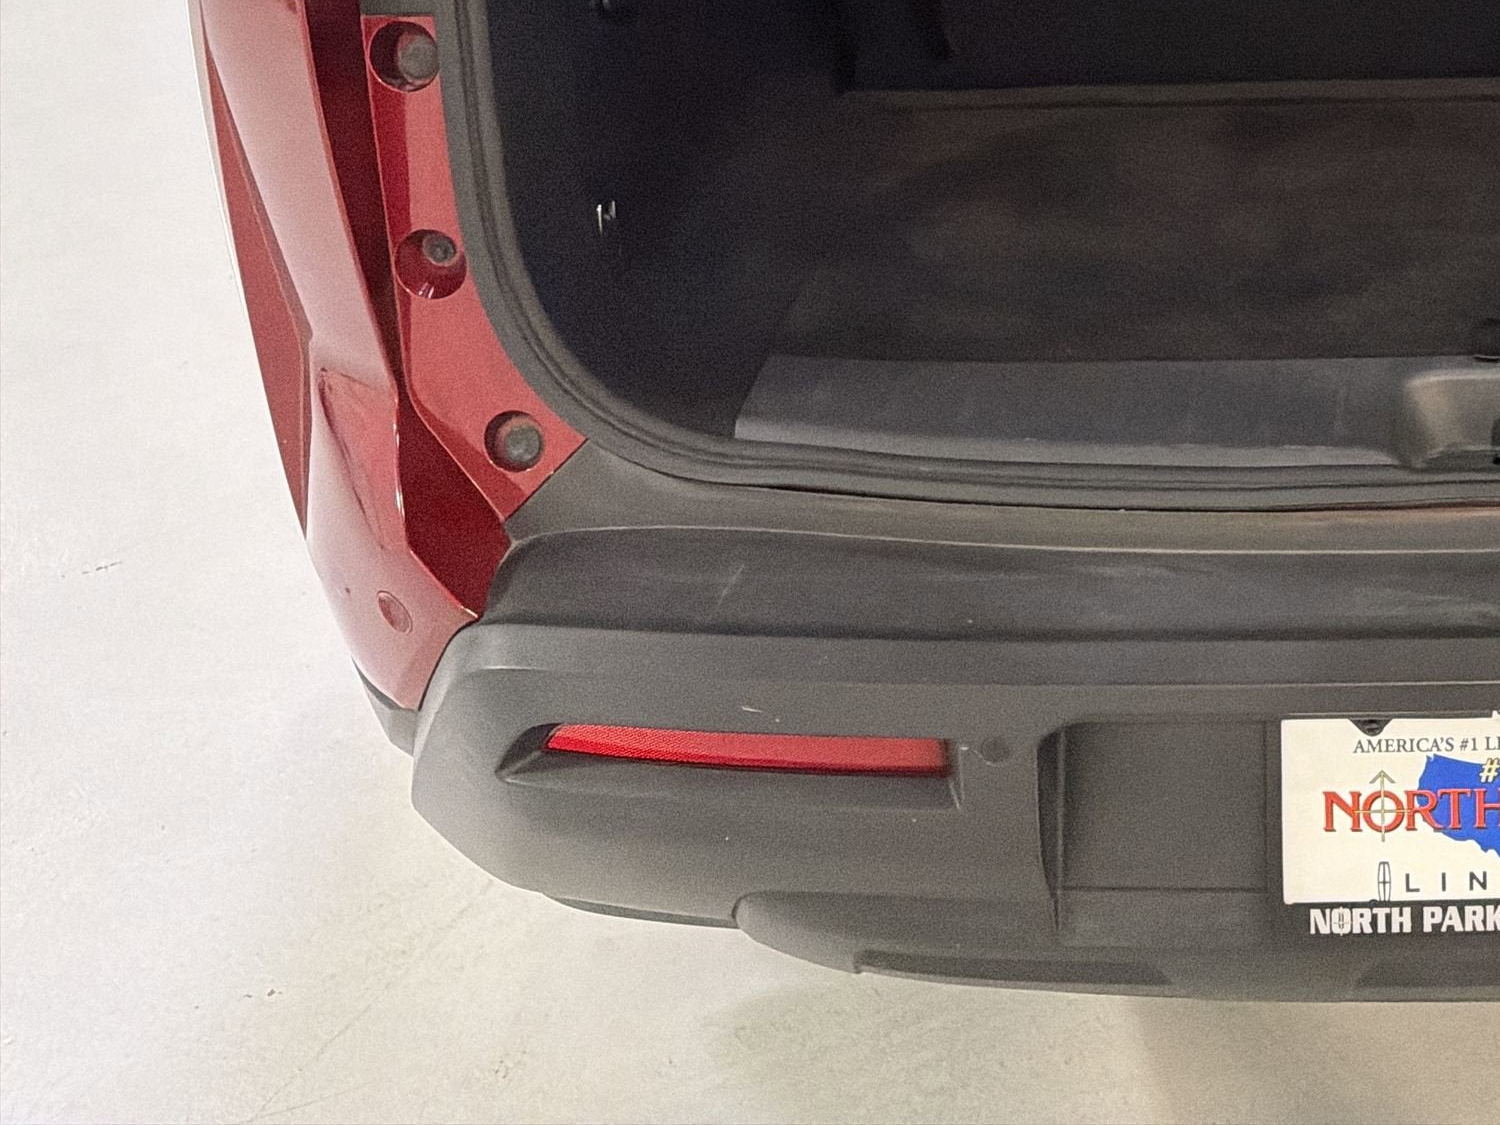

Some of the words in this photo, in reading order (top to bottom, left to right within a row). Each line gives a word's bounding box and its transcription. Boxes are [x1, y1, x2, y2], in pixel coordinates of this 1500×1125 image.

[1353, 737, 1454, 753] AMERICA'S
[1459, 736, 1478, 751] #1
[1309, 906, 1412, 935] NORTH
